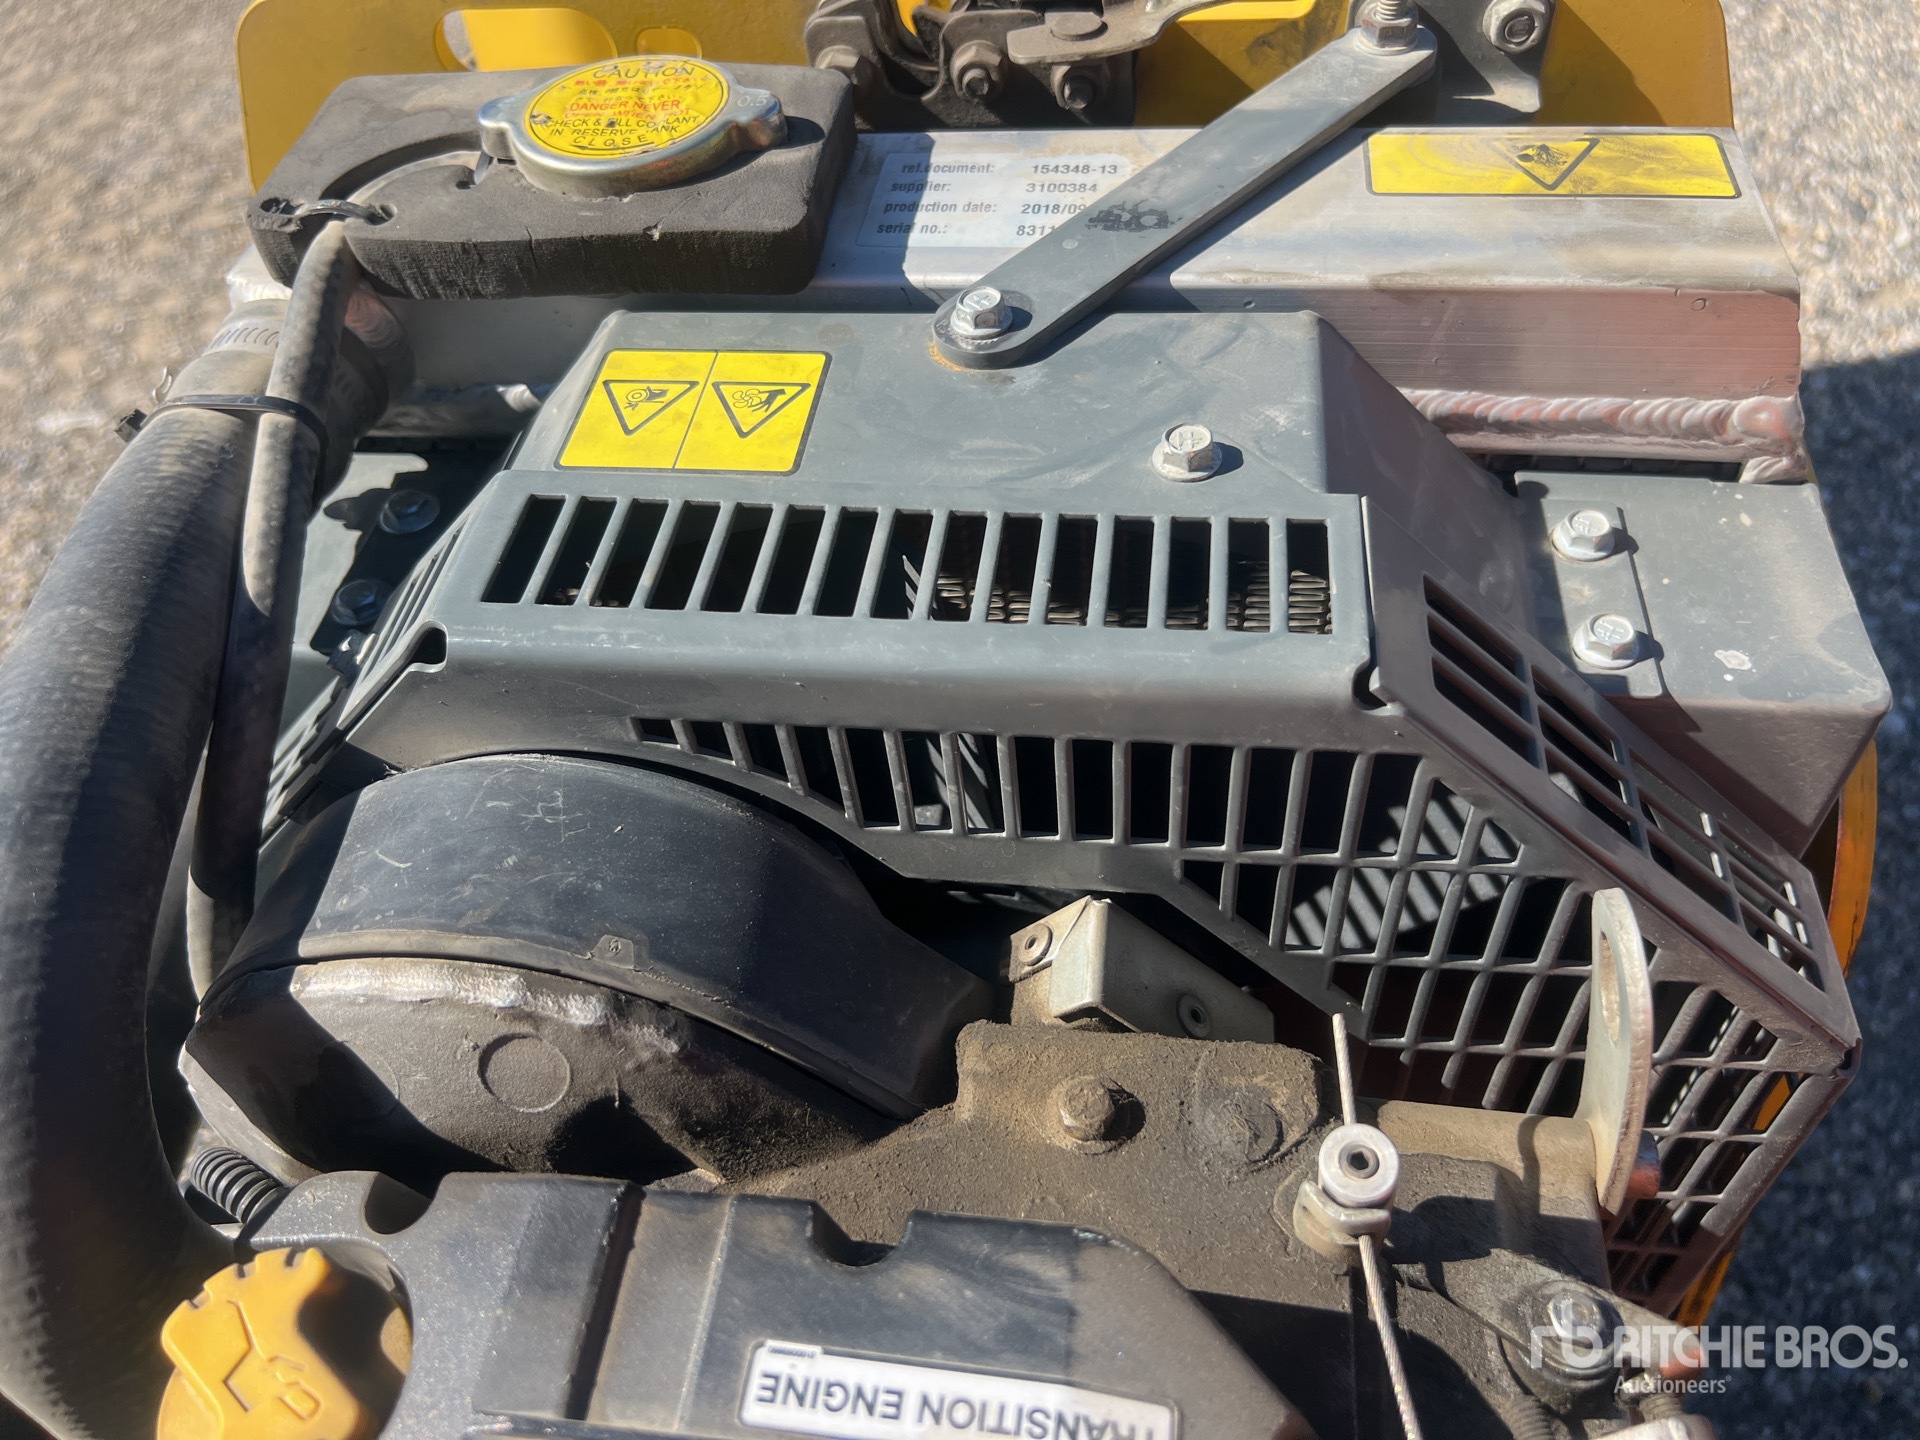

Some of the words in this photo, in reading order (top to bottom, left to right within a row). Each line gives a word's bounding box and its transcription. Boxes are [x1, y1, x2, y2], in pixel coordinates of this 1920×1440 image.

[593, 66, 695, 79] CAUTION
[569, 101, 628, 112] DANGER
[632, 99, 681, 112] NEVER
[737, 92, 768, 108] 0.5
[636, 116, 700, 129] COLANT
[550, 128, 565, 136] IN
[646, 125, 680, 135] ANK
[572, 135, 649, 147] CLOSE
[1032, 164, 1118, 175] 154348-13
[890, 181, 951, 193] supplier:
[1025, 182, 1098, 193] 3100384
[883, 201, 957, 215] production
[962, 201, 997, 213] date:
[876, 222, 912, 234] serial
[919, 223, 948, 234] no.:
[757, 1372, 905, 1420] ENGINE
